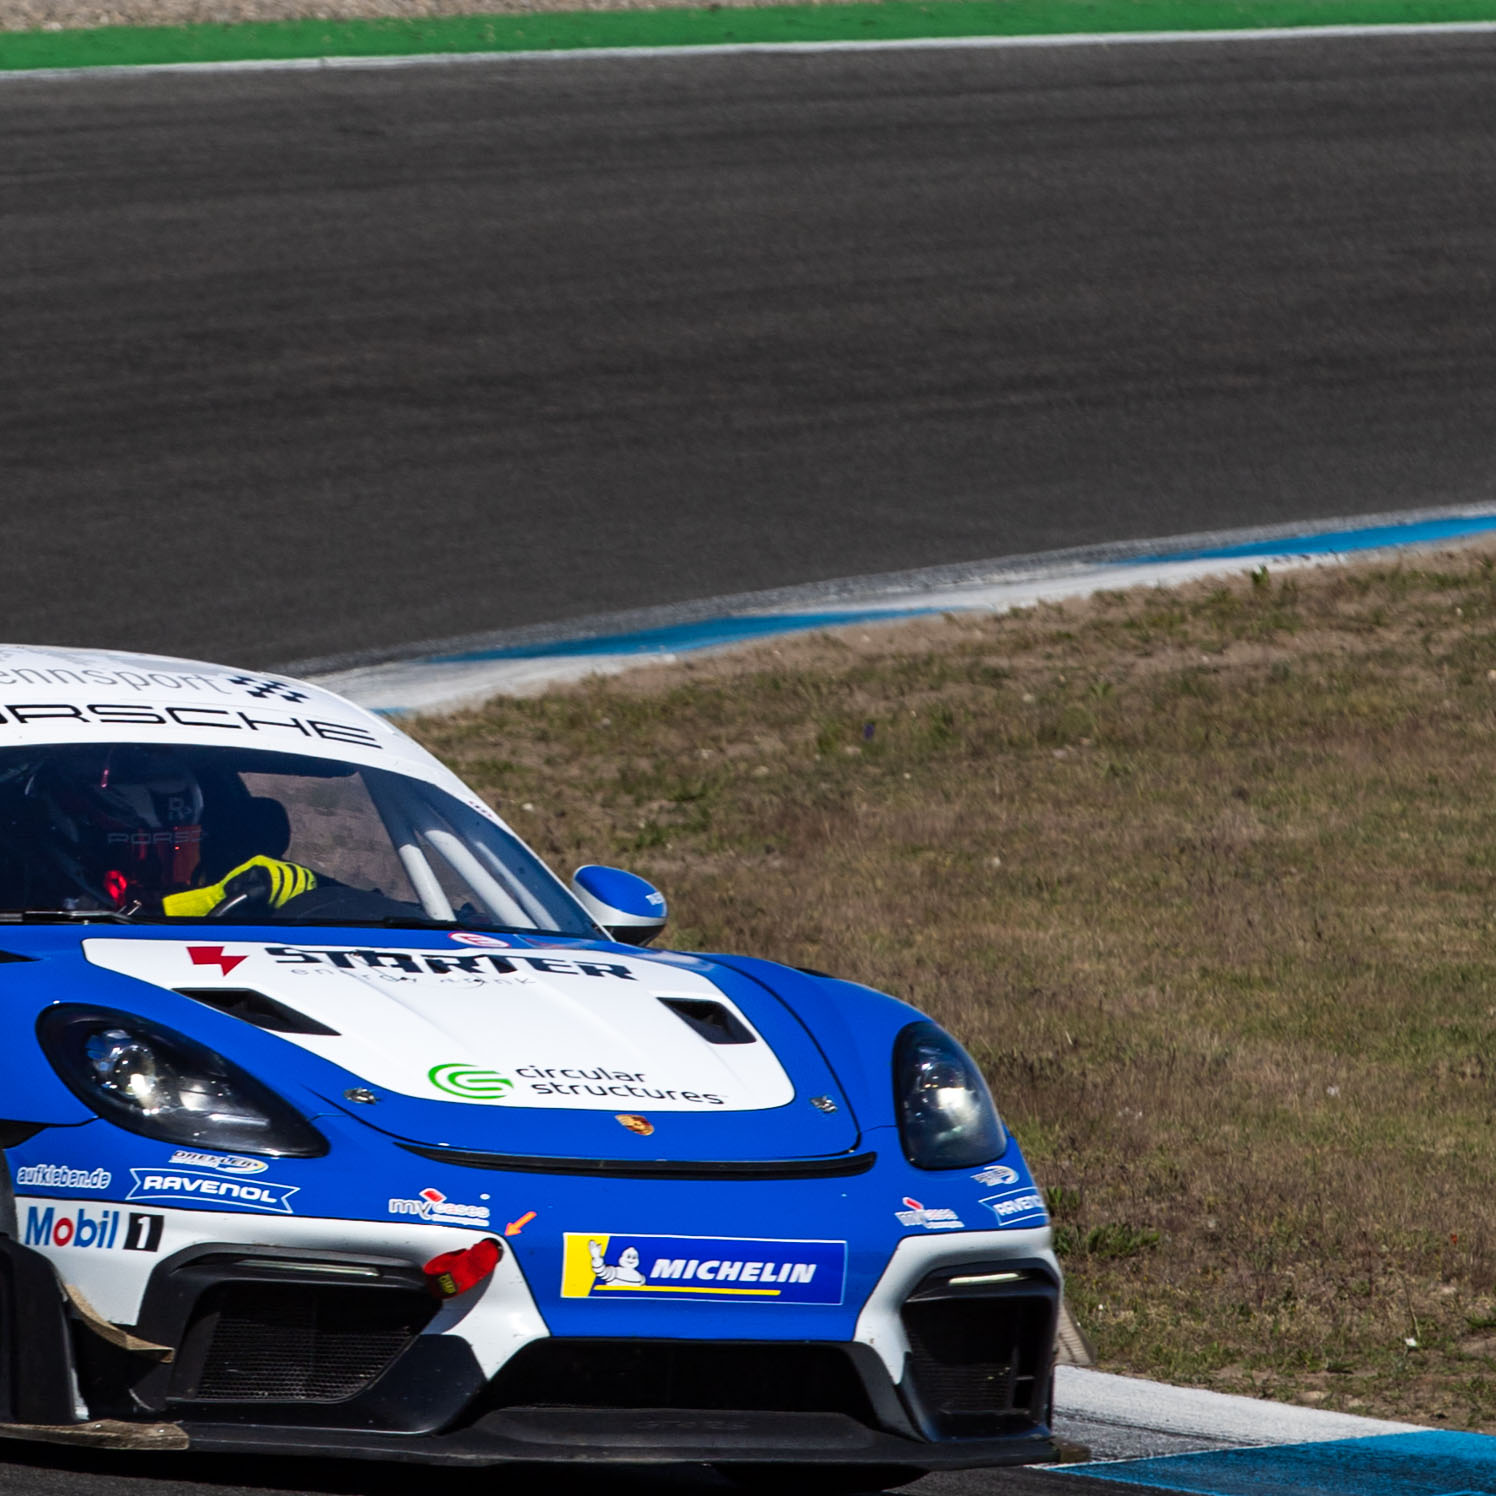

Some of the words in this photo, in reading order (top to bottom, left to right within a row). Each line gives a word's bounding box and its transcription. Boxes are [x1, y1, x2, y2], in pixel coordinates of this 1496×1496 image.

[265, 947, 638, 981] STARTER
[515, 1065, 646, 1083] circular
[531, 1082, 725, 1105] structures
[17, 1165, 111, 1189] aufkleben.de
[143, 1175, 277, 1203] RAVENOL
[25, 1206, 120, 1249] Mobil
[650, 1258, 817, 1284] MICHELIN
